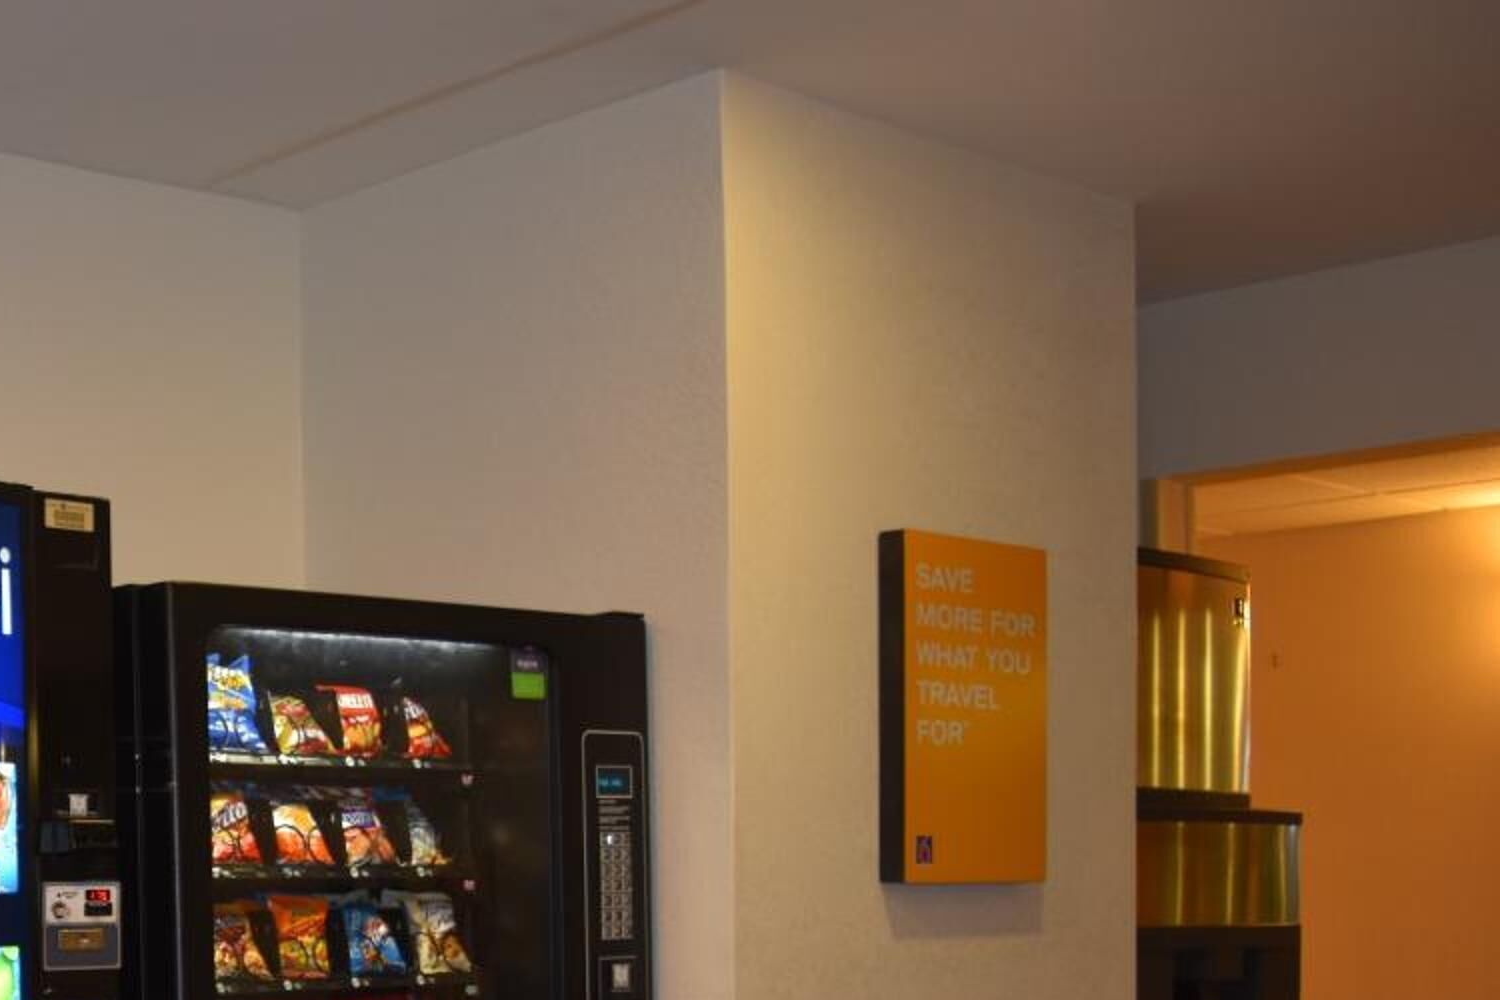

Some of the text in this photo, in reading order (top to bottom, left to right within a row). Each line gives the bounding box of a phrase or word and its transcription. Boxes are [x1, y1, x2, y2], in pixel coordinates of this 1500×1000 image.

[916, 561, 974, 593] SAVE
[916, 602, 1036, 639] MORE FOR
[916, 640, 1032, 676] WHAT YOU
[916, 678, 1001, 711] TRAVEL
